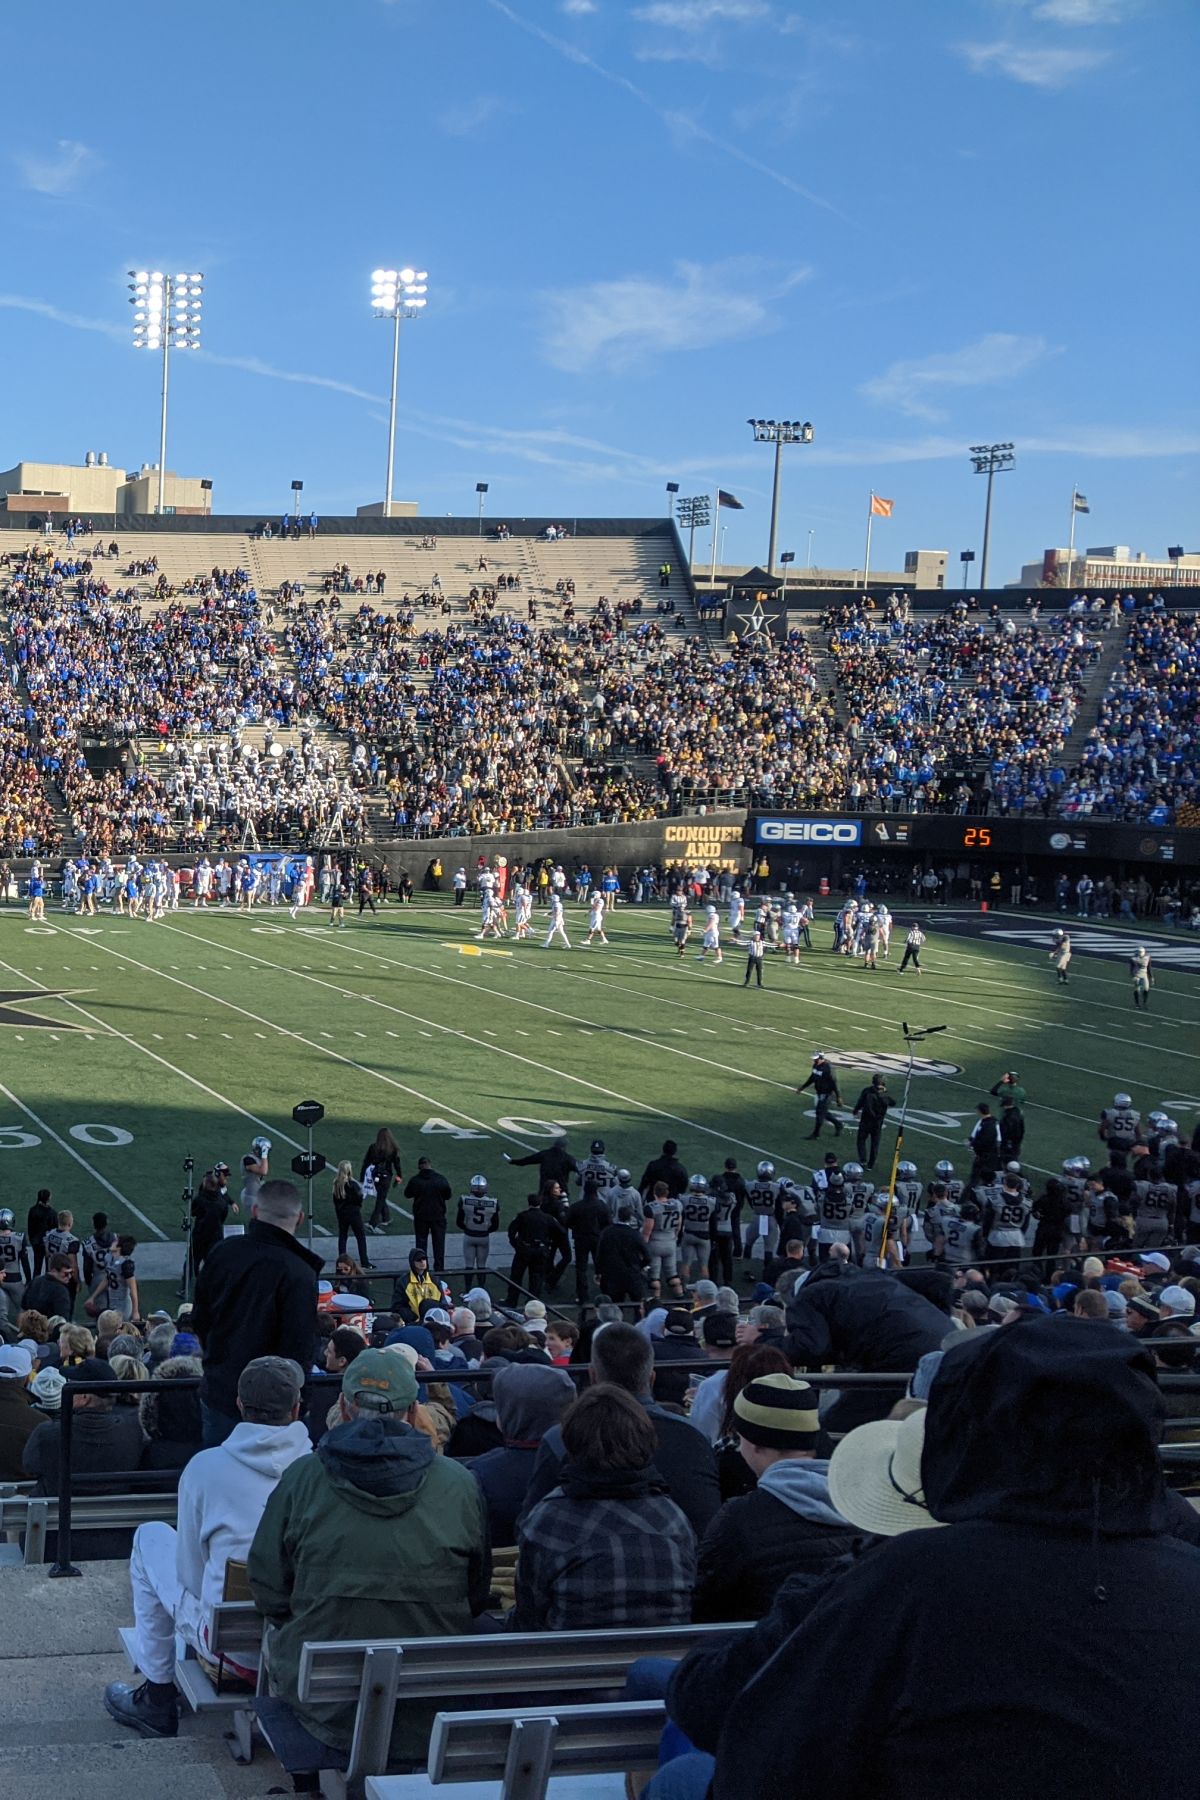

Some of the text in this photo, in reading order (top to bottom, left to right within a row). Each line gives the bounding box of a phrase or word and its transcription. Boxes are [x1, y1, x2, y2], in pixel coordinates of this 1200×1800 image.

[751, 616, 764, 630] V
[665, 826, 743, 842] CONQUER
[760, 822, 858, 842] GEICO
[964, 828, 991, 846] 25
[684, 842, 722, 858] AND
[1113, 1117, 1134, 1132] 55
[750, 1191, 774, 1208] 28
[473, 1207, 486, 1225] 5
[685, 1204, 710, 1222] 22
[823, 1202, 847, 1220] 85
[1001, 1206, 1023, 1223] 69
[662, 1211, 680, 1229] 72
